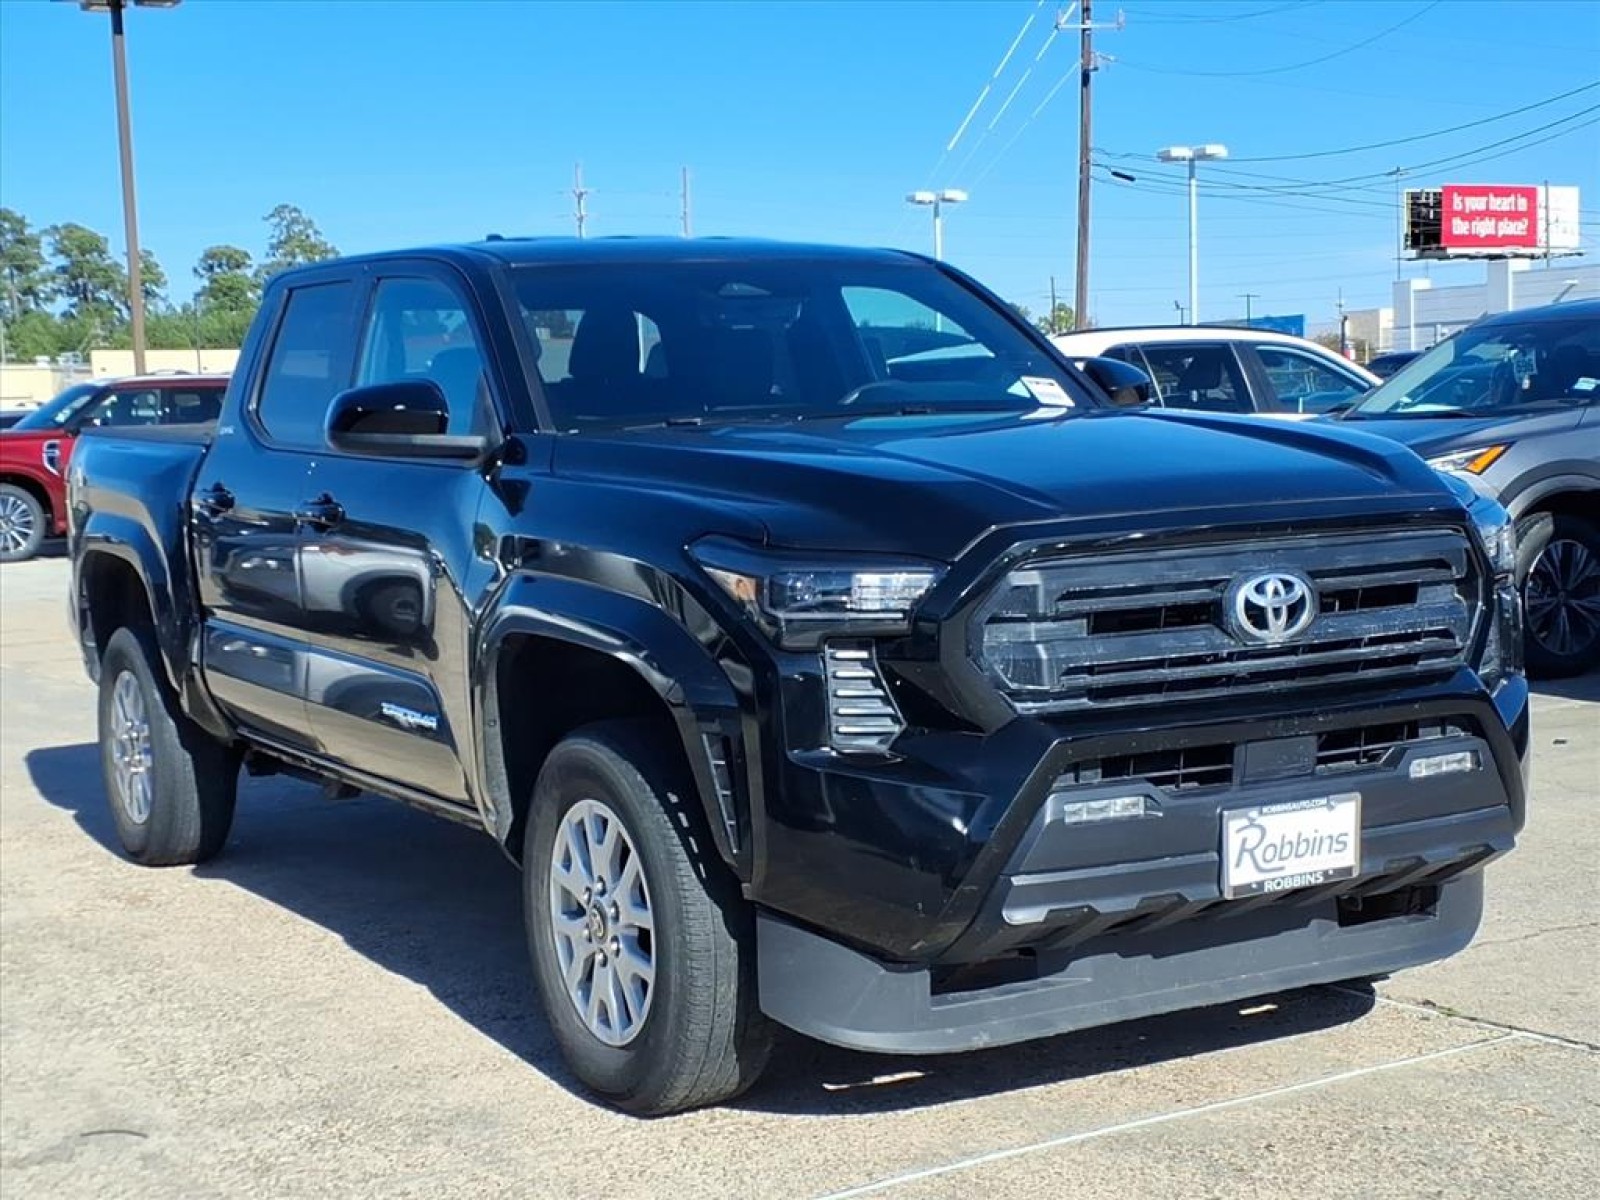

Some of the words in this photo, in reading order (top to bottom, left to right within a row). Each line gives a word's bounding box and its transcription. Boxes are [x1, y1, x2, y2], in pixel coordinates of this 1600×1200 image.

[1452, 192, 1462, 211] Is
[1465, 195, 1488, 213] your
[1489, 193, 1514, 211] heart
[1516, 194, 1528, 211] in
[1452, 217, 1469, 235] the
[1472, 217, 1496, 237] right
[1499, 218, 1529, 237] place?
[1235, 824, 1349, 873] Robbins
[1263, 871, 1324, 893] ROBBINS
